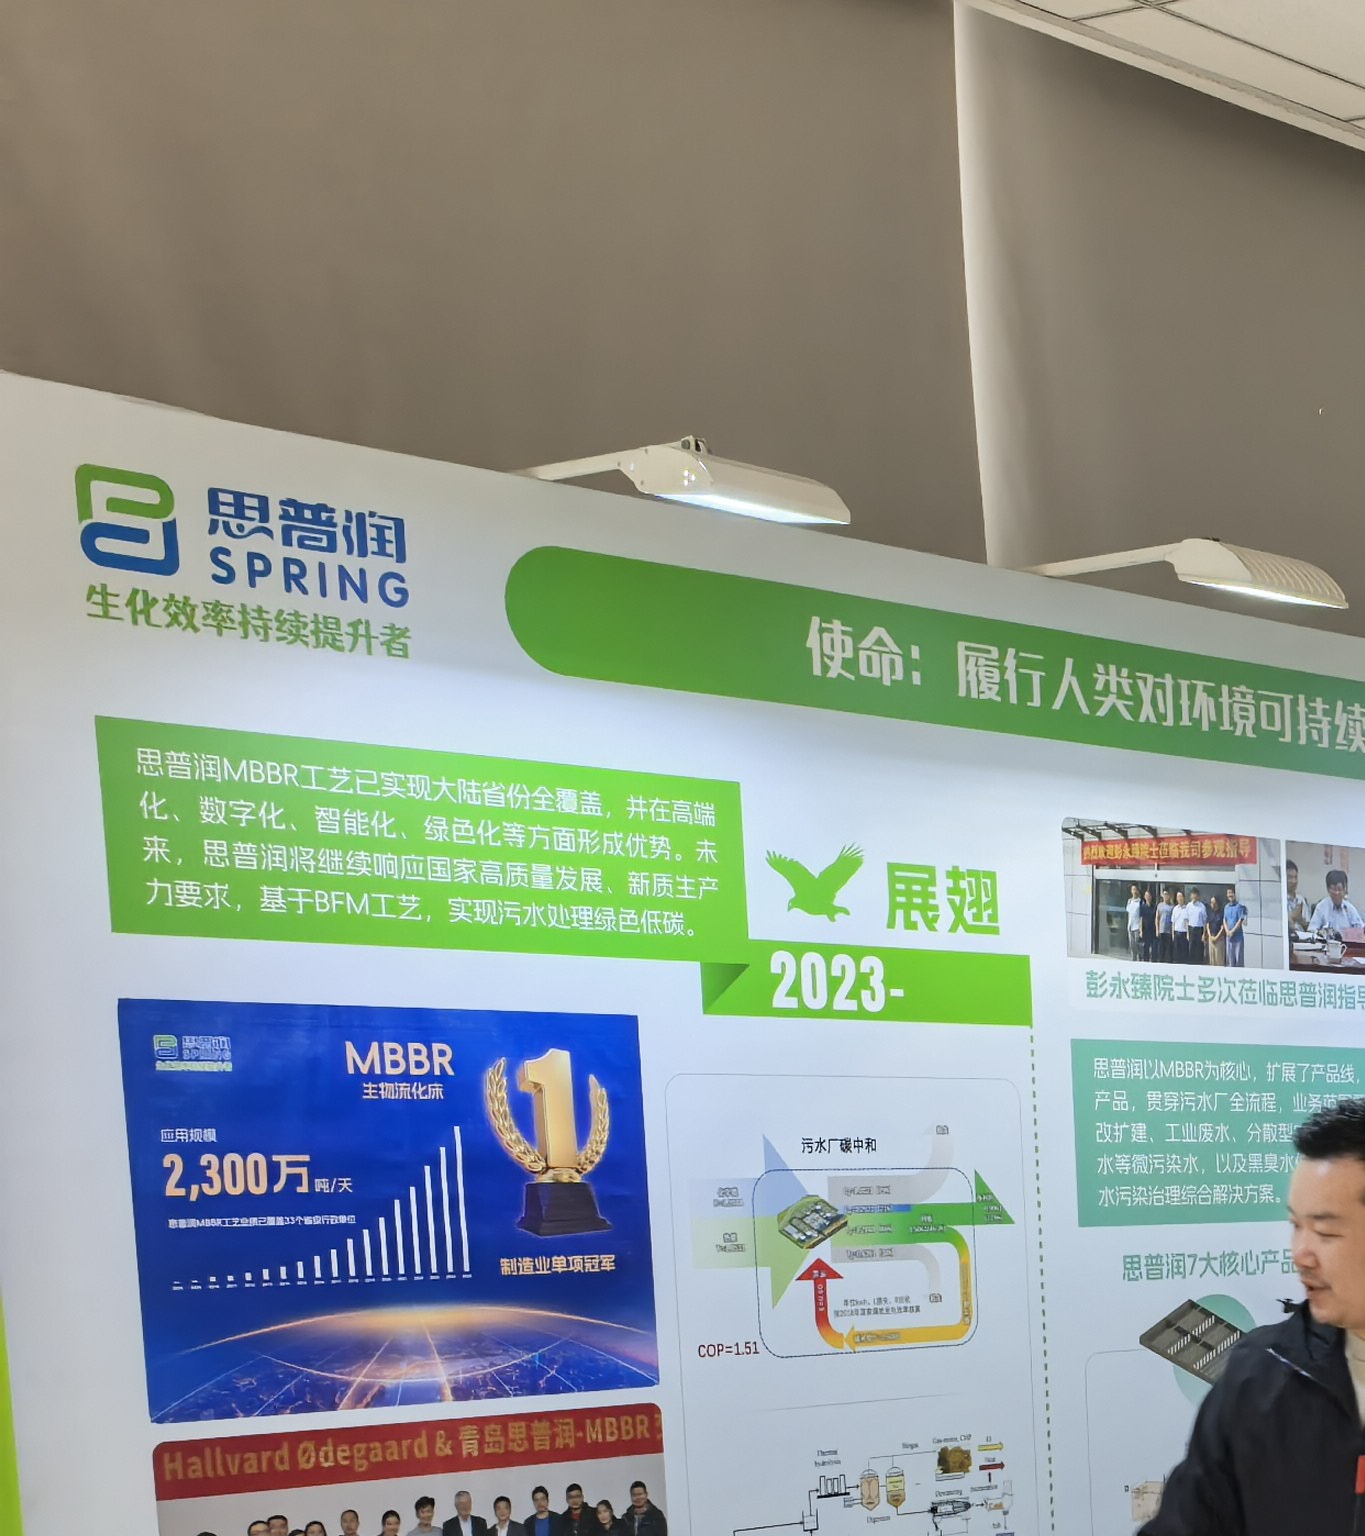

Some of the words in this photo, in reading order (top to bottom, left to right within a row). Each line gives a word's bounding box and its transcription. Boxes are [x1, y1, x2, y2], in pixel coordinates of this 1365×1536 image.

[207, 487, 408, 564] 思普润
[210, 547, 410, 609] SPRING
[87, 584, 412, 659] 生化效率持续提升者
[135, 747, 716, 828] 思普润MBBR工艺已实现大陆省份全覆盖，并在高端
[139, 796, 718, 864] 化、数字化、智能化、绿色化等方面形成优势。未
[142, 835, 719, 901] 来，思普润将继续响应国家高质量发展、新质生产
[145, 878, 695, 938] 力要求，基于BFM工艺，实现污水处理绿色低碳。
[885, 861, 1000, 935] 展翅
[769, 951, 905, 1012] 2023-
[344, 1041, 455, 1077] MBBR
[362, 1081, 445, 1101] 生物流化床
[160, 1128, 218, 1143] 应用规模
[801, 1136, 878, 1155] 污水厂碳中和
[1095, 1121, 1300, 1144] 改扩建、工业废水、分散型
[1097, 1153, 1300, 1176] 水等微污染水，以及黑臭水
[1098, 1183, 1282, 1208] 水污染治理综合解决方案。
[500, 1254, 616, 1276] 制造业单项冠军
[698, 1342, 761, 1358] COP=1.51
[163, 1440, 291, 1482] Hallvard
[297, 1430, 429, 1475] Ødegaard
[434, 1432, 453, 1456] &
